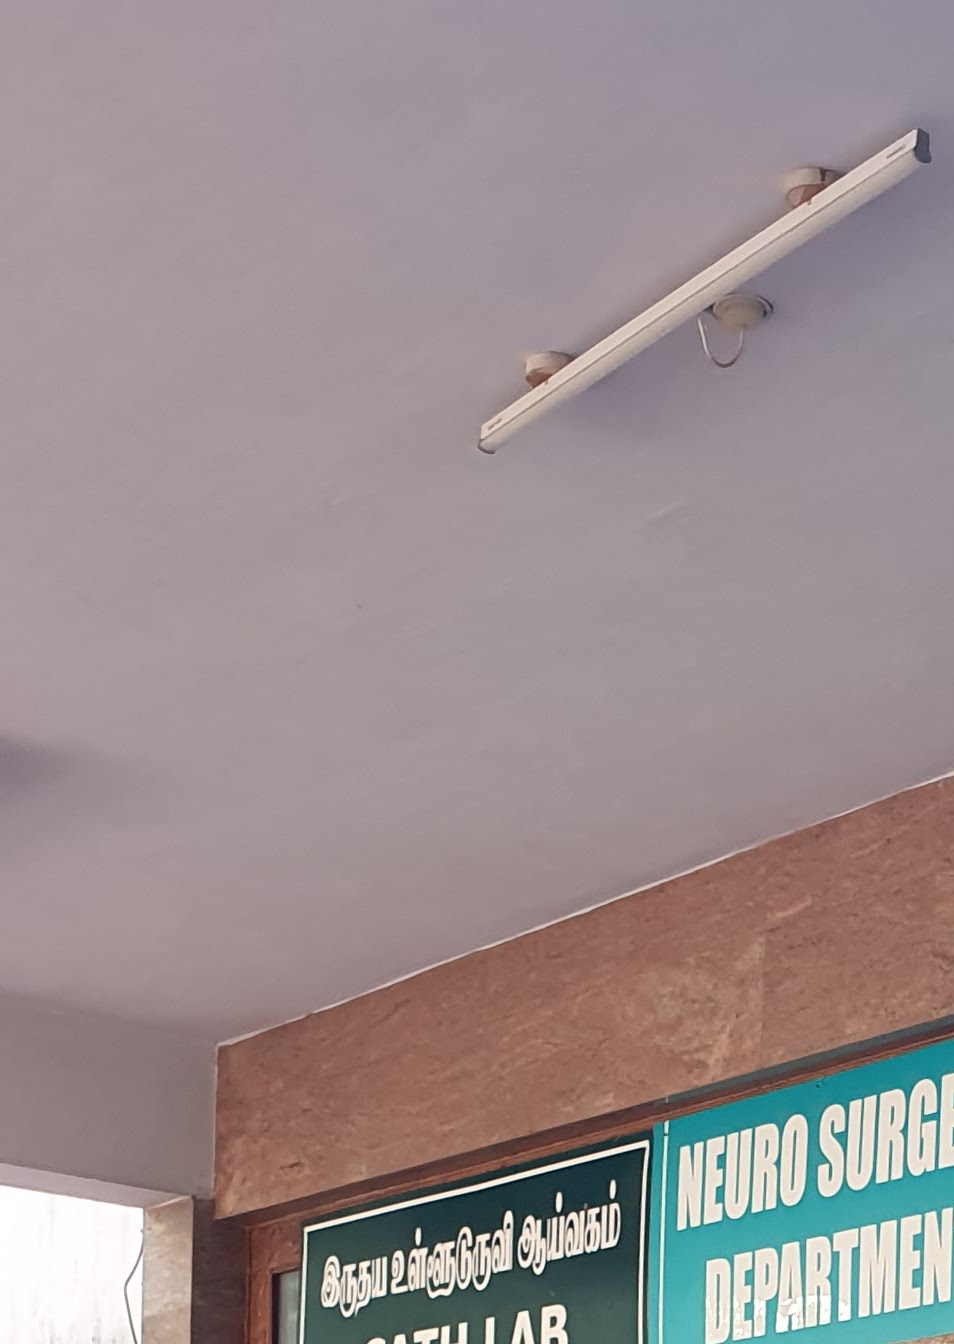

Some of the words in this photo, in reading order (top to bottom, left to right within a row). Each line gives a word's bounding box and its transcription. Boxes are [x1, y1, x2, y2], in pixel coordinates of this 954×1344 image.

[676, 1113, 809, 1232] NEURO
[320, 1256, 388, 1317] இருதய
[391, 1210, 514, 1299] உள்ளூடுருவி
[517, 1179, 622, 1275] ஆய்வகம்
